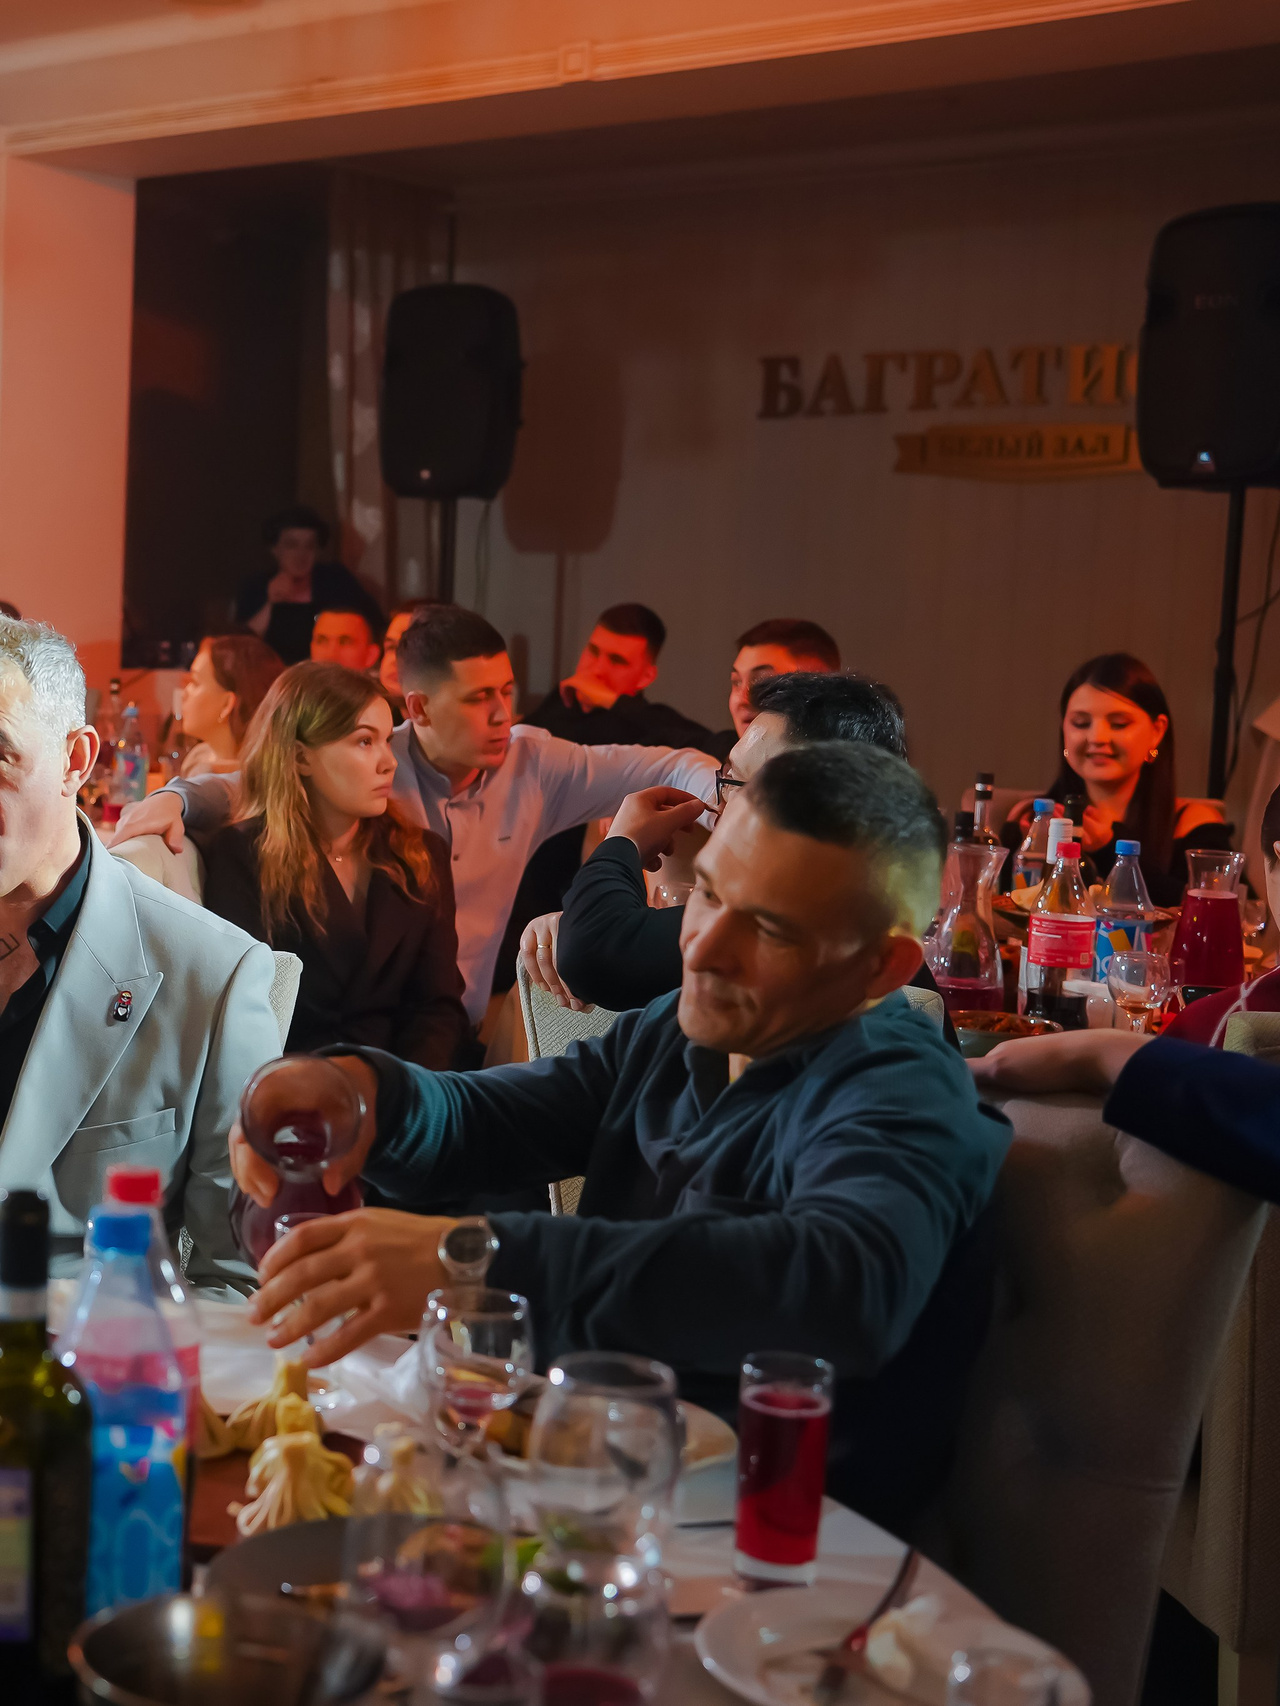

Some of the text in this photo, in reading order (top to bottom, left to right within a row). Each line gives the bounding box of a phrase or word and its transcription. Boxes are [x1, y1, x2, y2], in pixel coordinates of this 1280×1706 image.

[757, 343, 1137, 419] БАГРАТИ
[938, 430, 1111, 460] БЕЛЫЙ ЗАЛ
